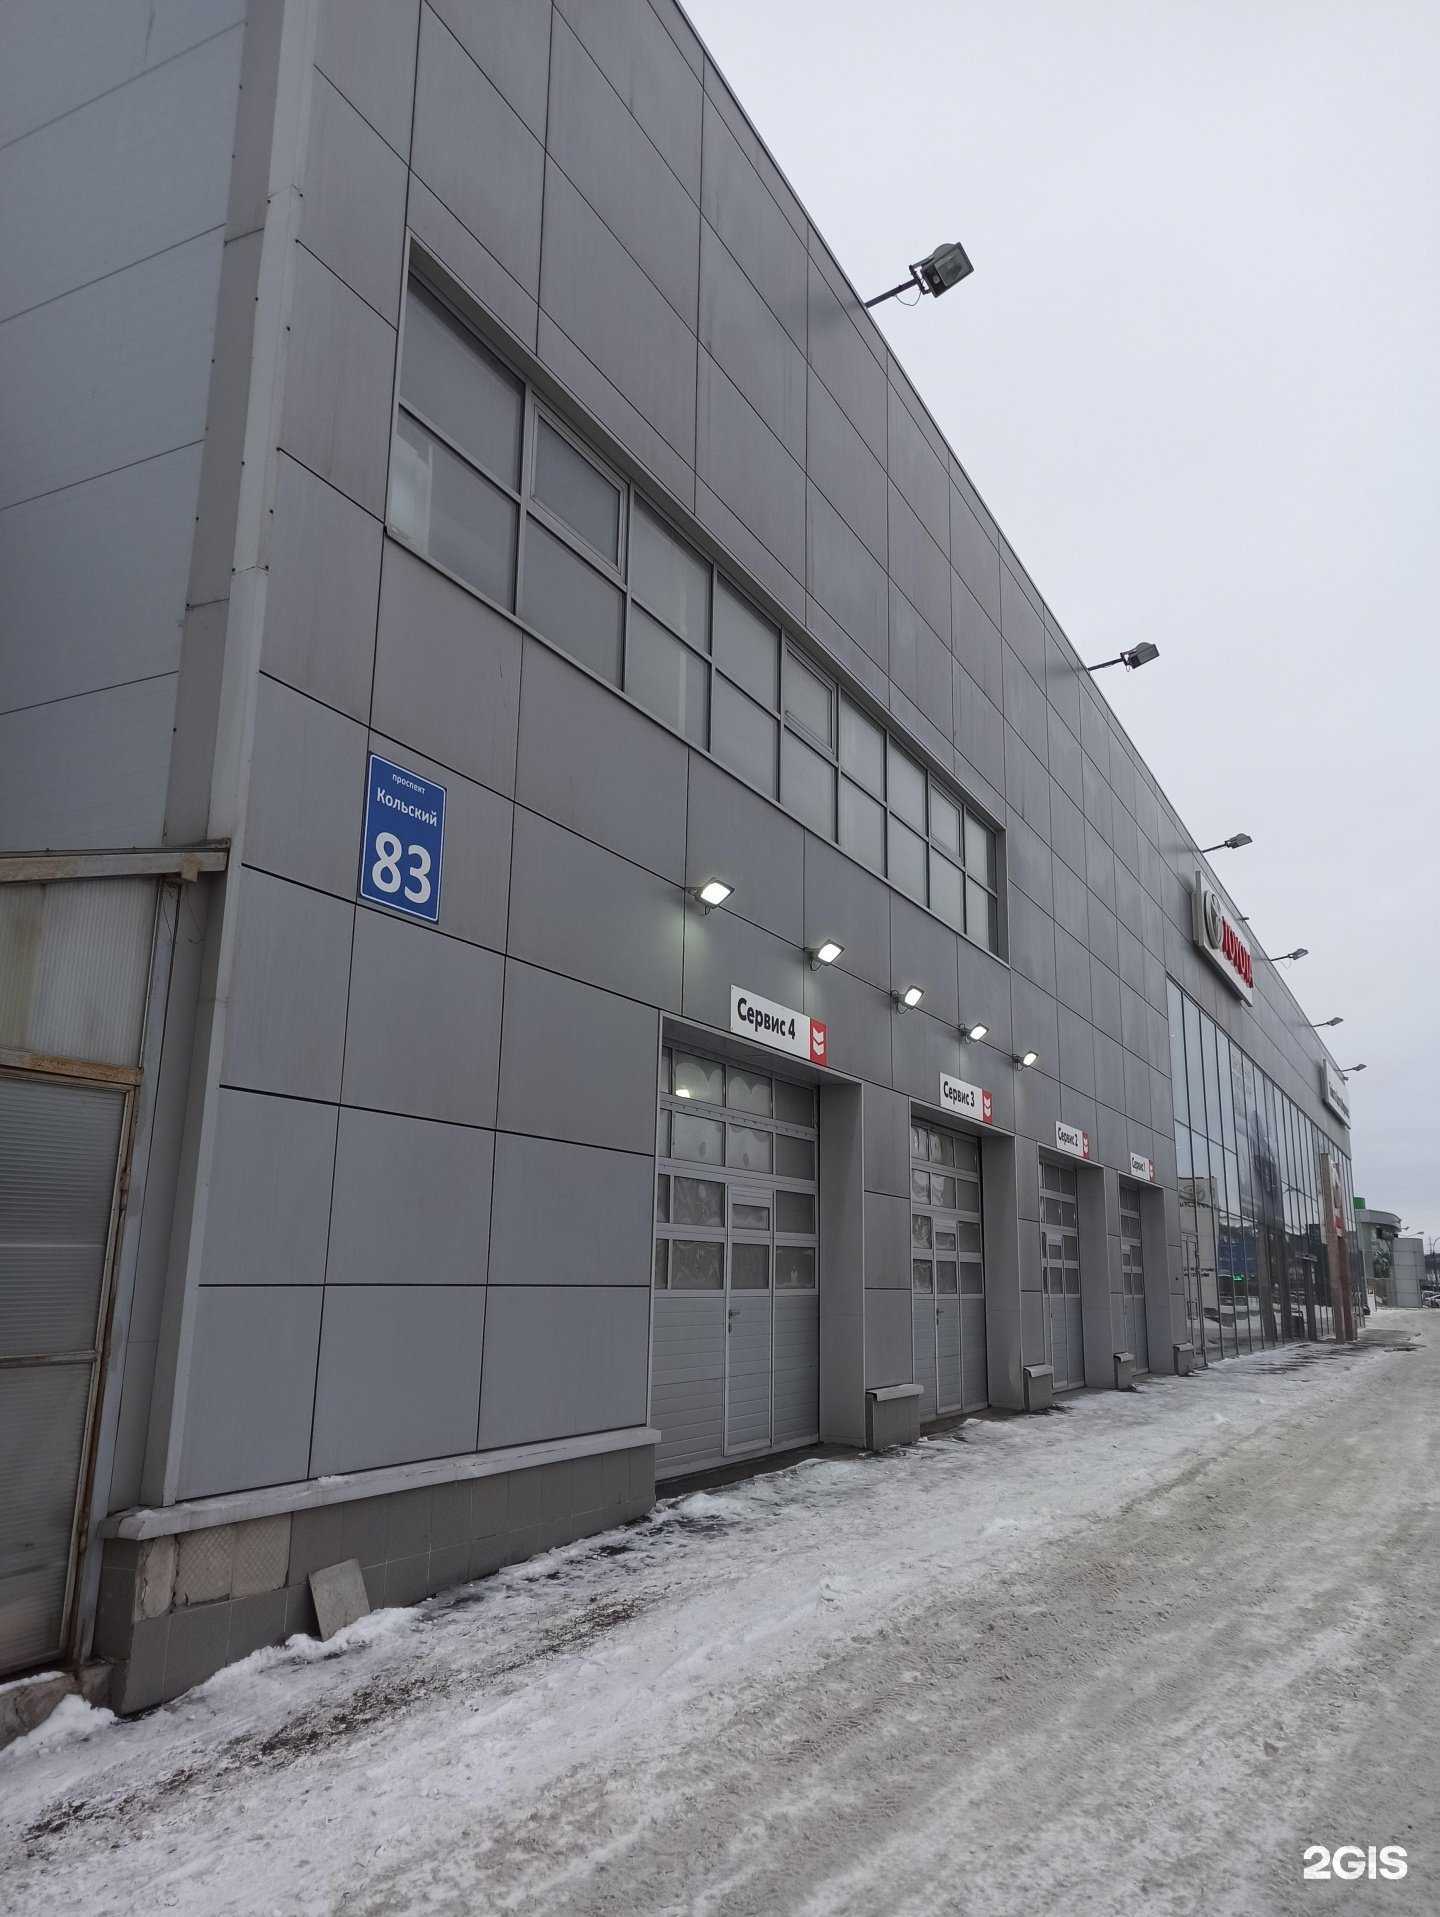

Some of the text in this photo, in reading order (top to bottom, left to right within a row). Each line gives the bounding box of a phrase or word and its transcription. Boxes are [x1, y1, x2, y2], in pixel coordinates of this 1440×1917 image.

[392, 773, 427, 795] проспект
[376, 786, 437, 827] Кольский
[371, 831, 432, 904] 83
[737, 997, 796, 1040] Сервис 4
[943, 1080, 975, 1108] Сервис 3
[1057, 1127, 1074, 1146] Сервис
